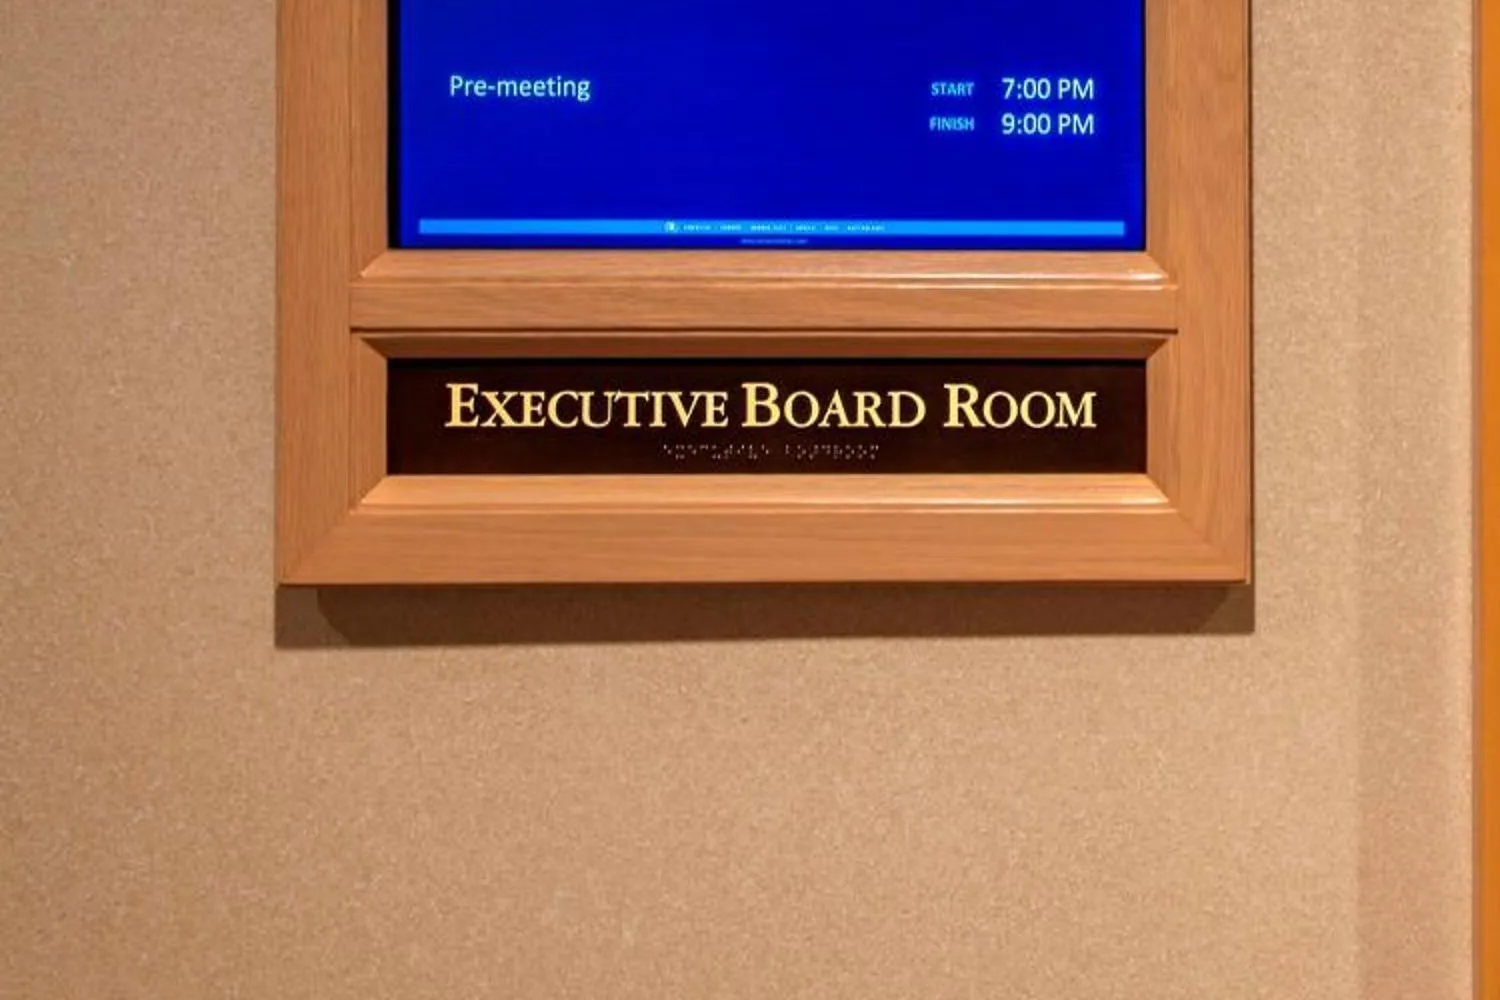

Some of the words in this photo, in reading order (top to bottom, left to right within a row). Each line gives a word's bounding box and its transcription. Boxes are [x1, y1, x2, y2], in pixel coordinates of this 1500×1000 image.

[448, 74, 592, 104] Pre-meeting
[930, 81, 975, 96] START
[1001, 77, 1052, 100] 7:00
[1057, 77, 1095, 100] PM
[929, 116, 975, 131] FINISH
[1001, 112, 1052, 135] 9:00
[1057, 112, 1095, 135] PM
[445, 383, 729, 428] EXECUTIVE
[741, 382, 927, 430] BOARD
[943, 383, 1097, 430] ROOM
